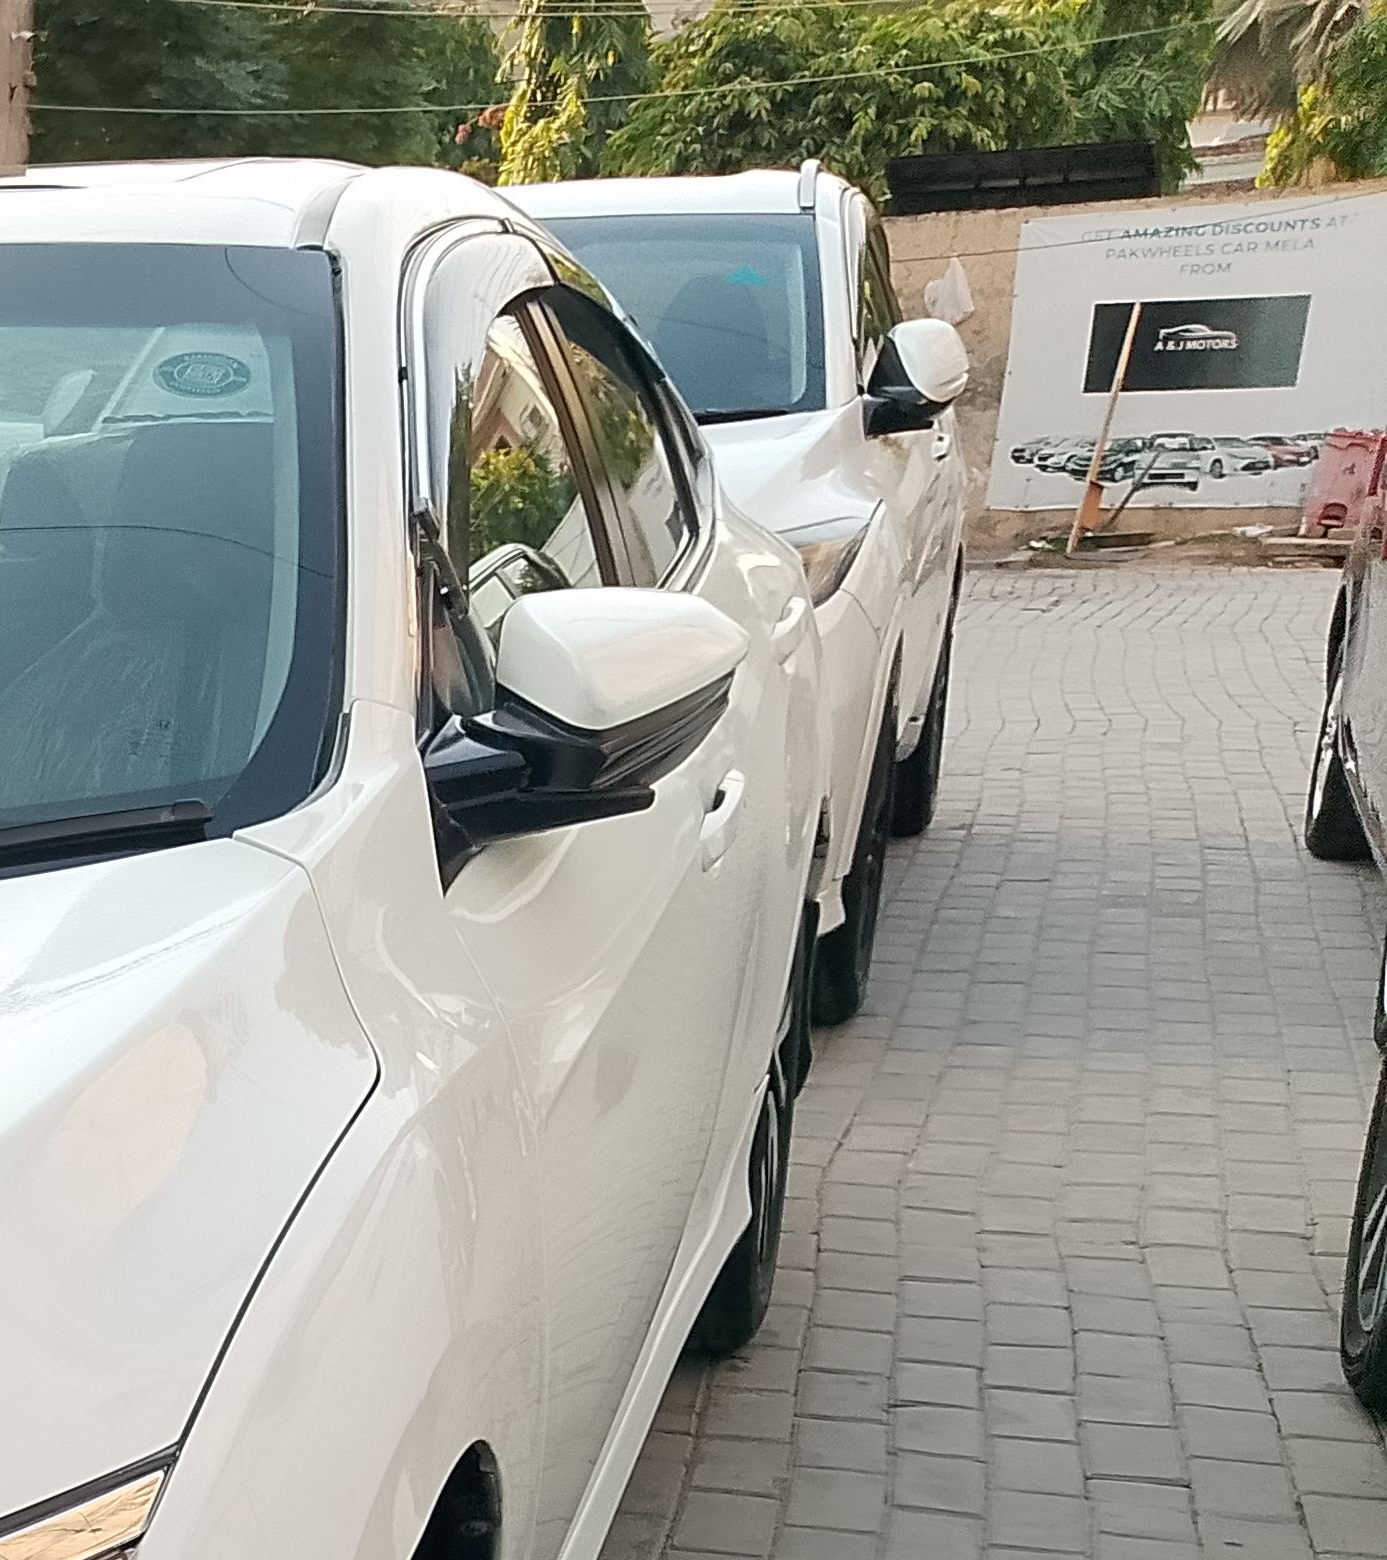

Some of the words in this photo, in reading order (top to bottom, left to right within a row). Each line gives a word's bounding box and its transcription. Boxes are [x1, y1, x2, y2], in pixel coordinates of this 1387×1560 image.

[1119, 224, 1207, 240] AMAZING
[1212, 217, 1321, 237] DISCOUNTS
[1105, 243, 1215, 261] PAKWHEELS
[1220, 240, 1259, 256] CAR
[1264, 237, 1316, 253] MELA
[1178, 262, 1233, 277] FROM
[1154, 341, 1164, 351] A
[1184, 338, 1239, 351] MOTORS
